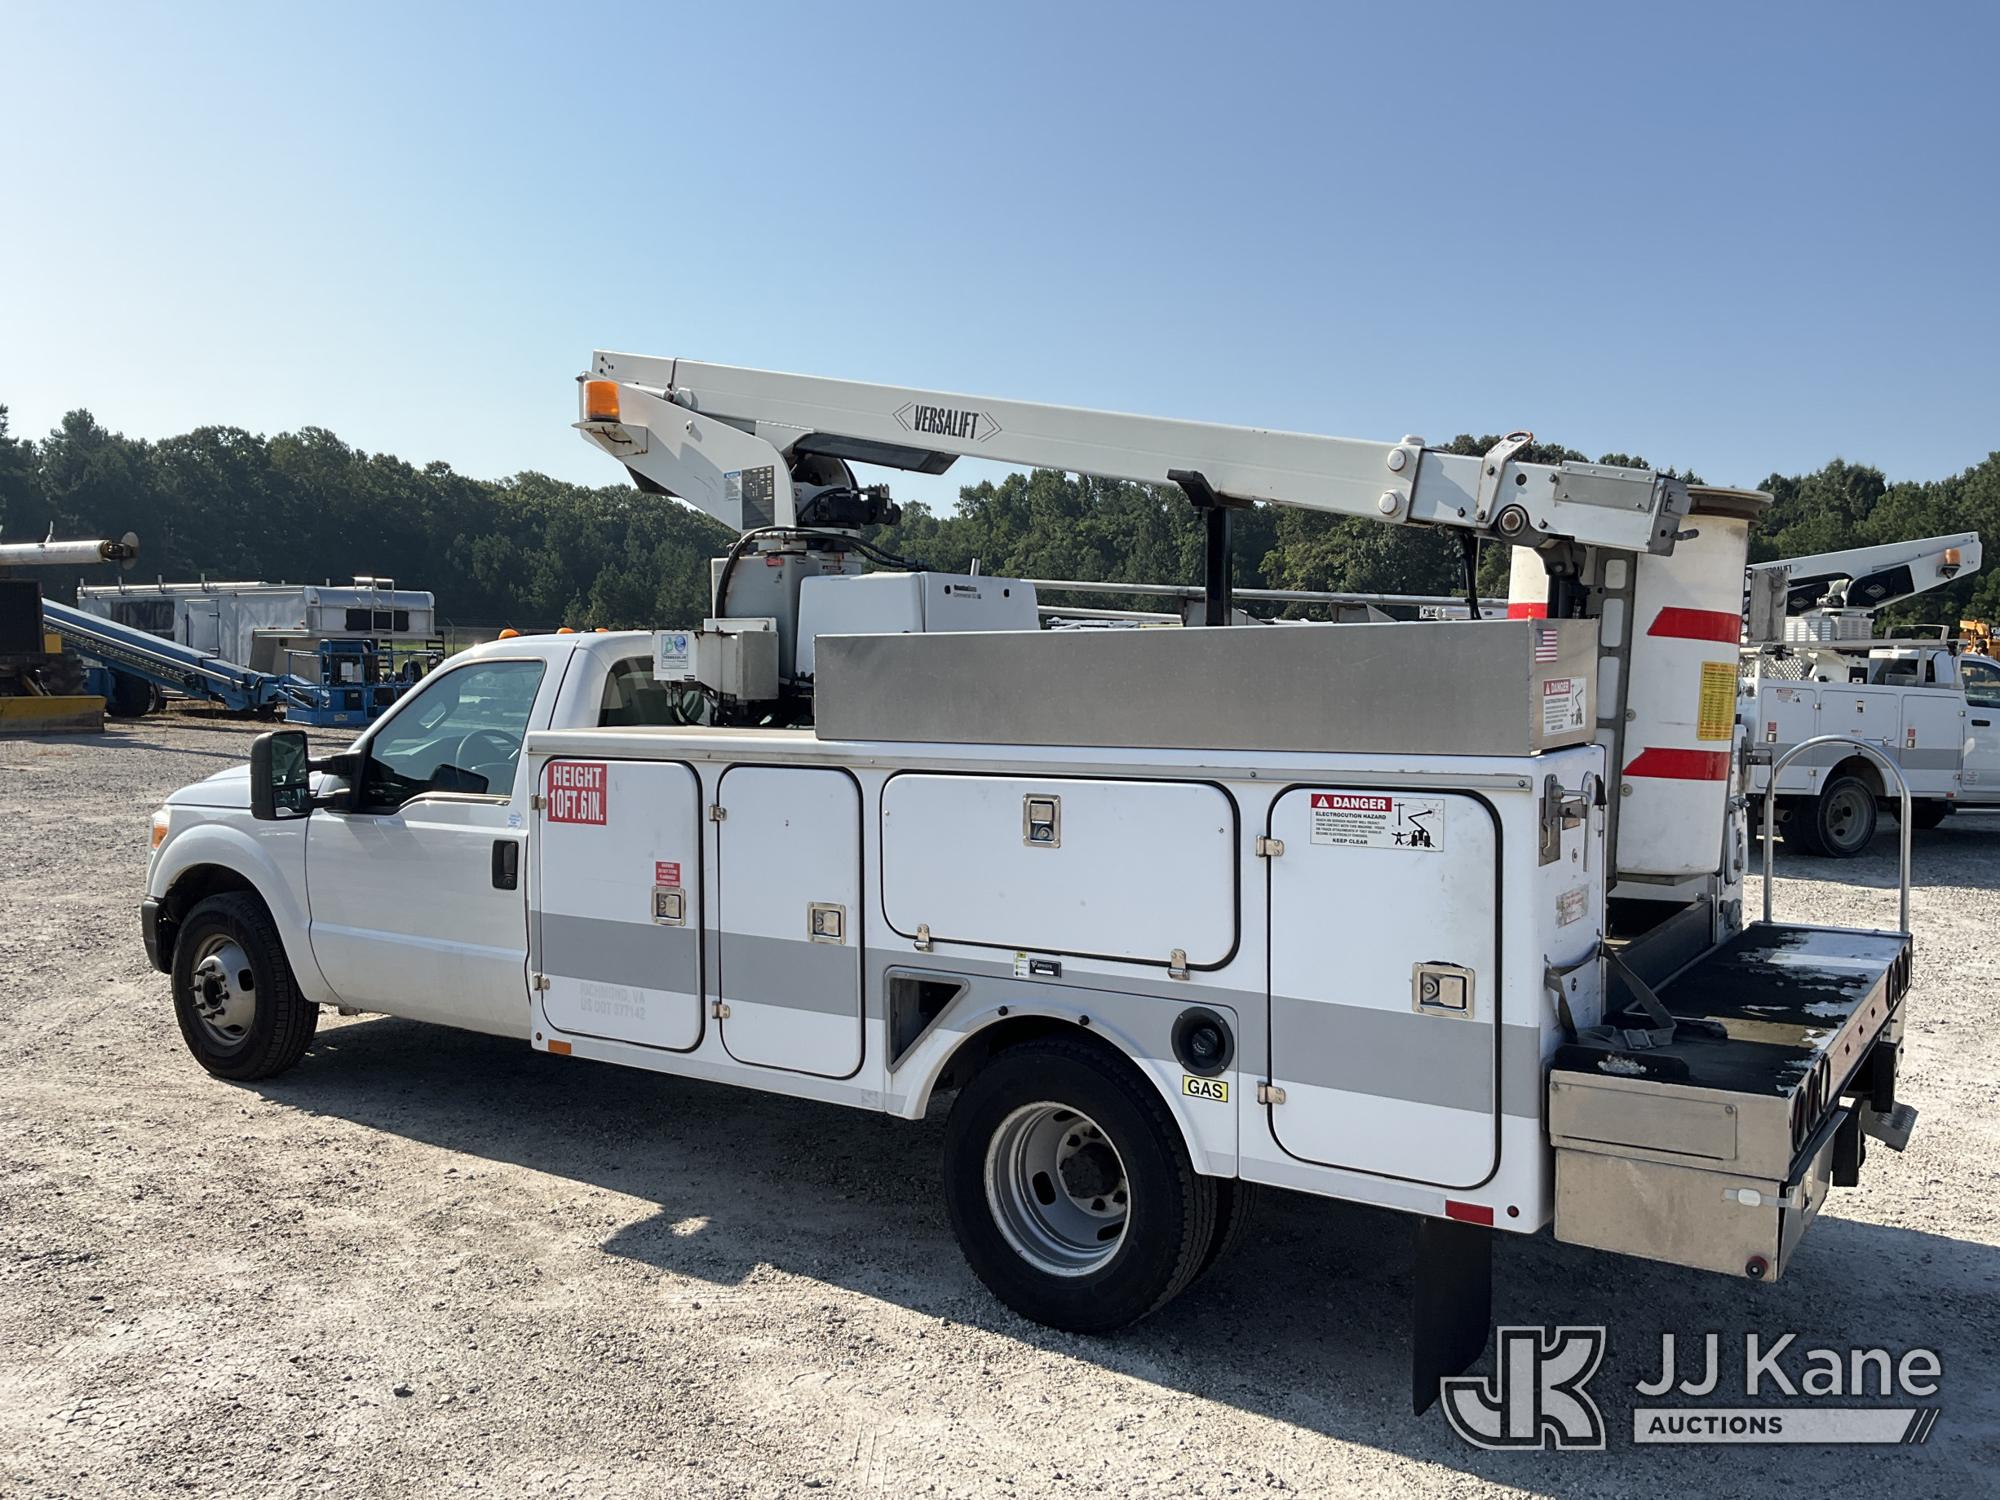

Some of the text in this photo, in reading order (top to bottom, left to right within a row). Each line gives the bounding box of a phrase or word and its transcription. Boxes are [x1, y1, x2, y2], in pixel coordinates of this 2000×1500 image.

[914, 404, 979, 440] VERSALIFT
[553, 765, 602, 788] HEIGHT
[550, 788, 604, 821] 10FT.6IN.
[1333, 797, 1386, 810] DANGER
[1315, 811, 1362, 819] ELECTROCUTION
[1187, 1079, 1223, 1099] GAS
